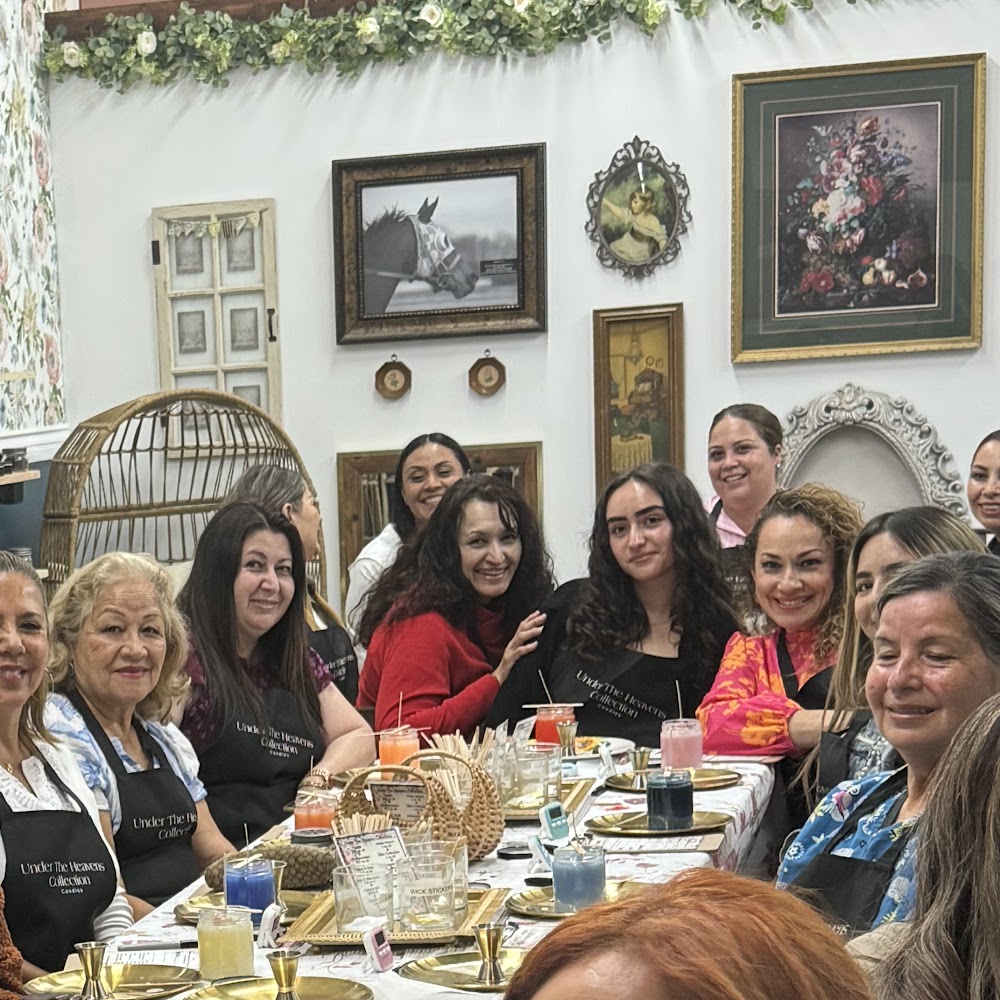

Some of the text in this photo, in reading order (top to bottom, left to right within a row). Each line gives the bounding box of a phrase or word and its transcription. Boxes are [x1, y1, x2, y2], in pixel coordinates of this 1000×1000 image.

[576, 669, 603, 690] Under
[624, 693, 667, 720] Heavens
[589, 690, 639, 719] Collection
[133, 815, 165, 829] Under
[166, 813, 185, 826] The
[20, 861, 106, 875] Under The Heavens
[48, 874, 92, 888] Collection
